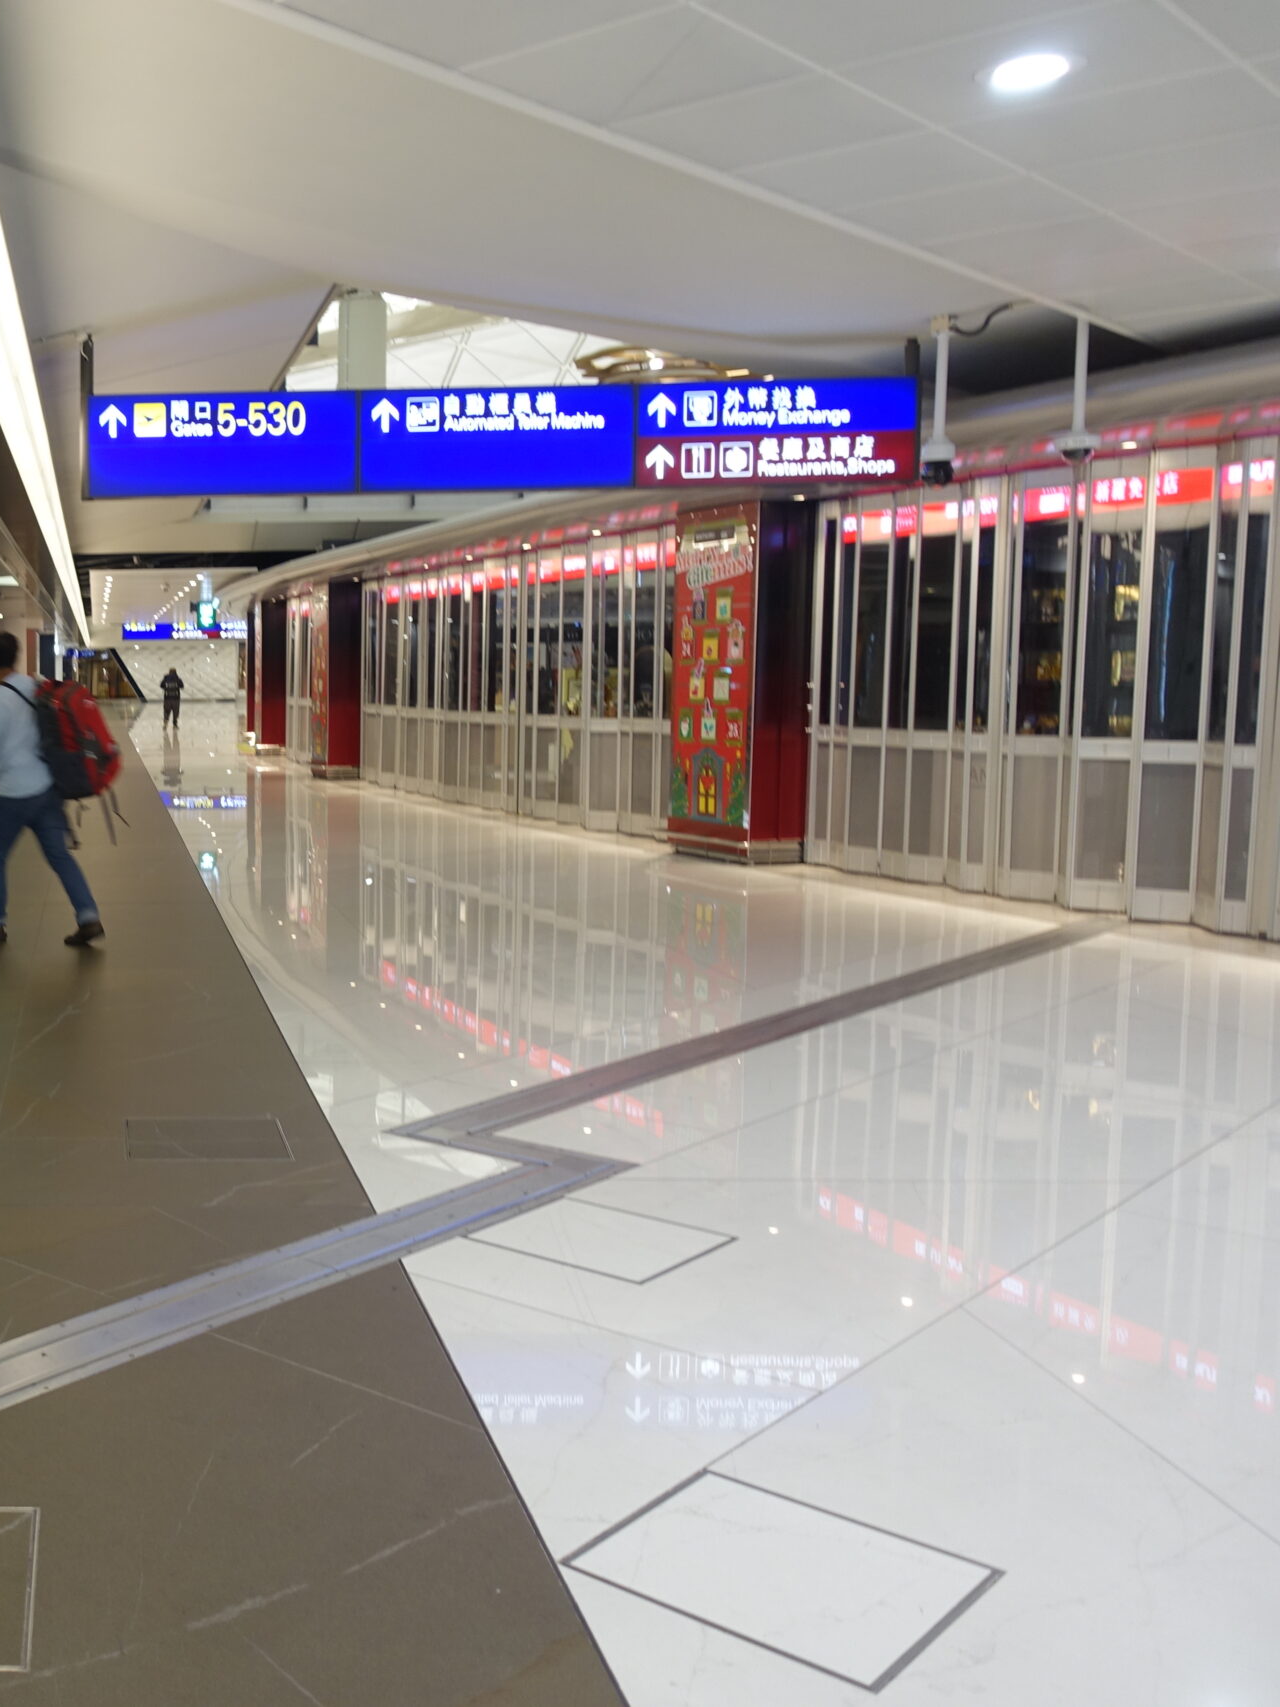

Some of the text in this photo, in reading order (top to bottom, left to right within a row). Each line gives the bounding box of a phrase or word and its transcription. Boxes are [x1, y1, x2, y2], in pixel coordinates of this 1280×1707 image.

[217, 400, 307, 437] 5-530
[723, 407, 851, 428] Money Exchange
